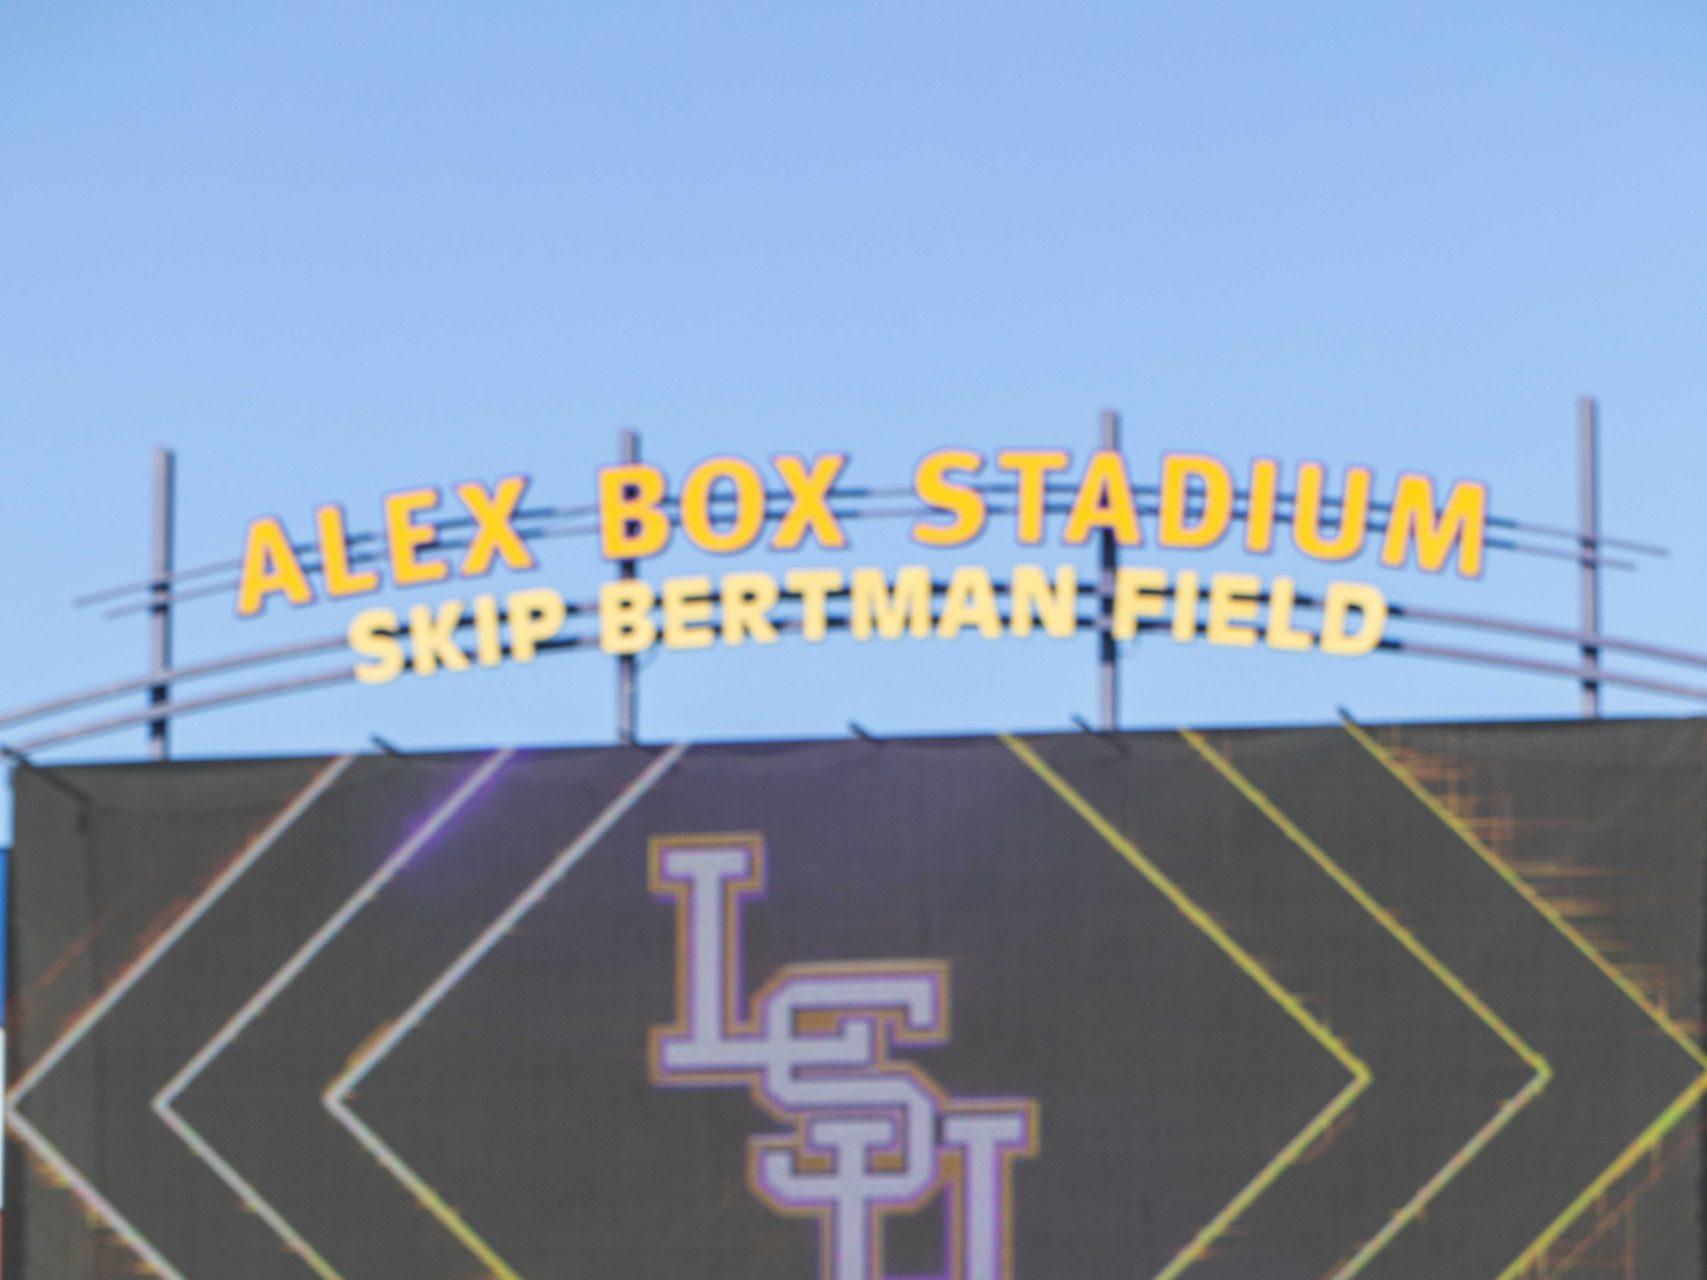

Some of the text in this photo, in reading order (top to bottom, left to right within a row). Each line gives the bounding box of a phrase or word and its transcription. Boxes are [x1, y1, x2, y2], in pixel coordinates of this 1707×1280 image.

[236, 449, 1488, 617] ALEX BOX STADIUM
[348, 564, 1389, 684] SKIP BERTMAN FIELD
